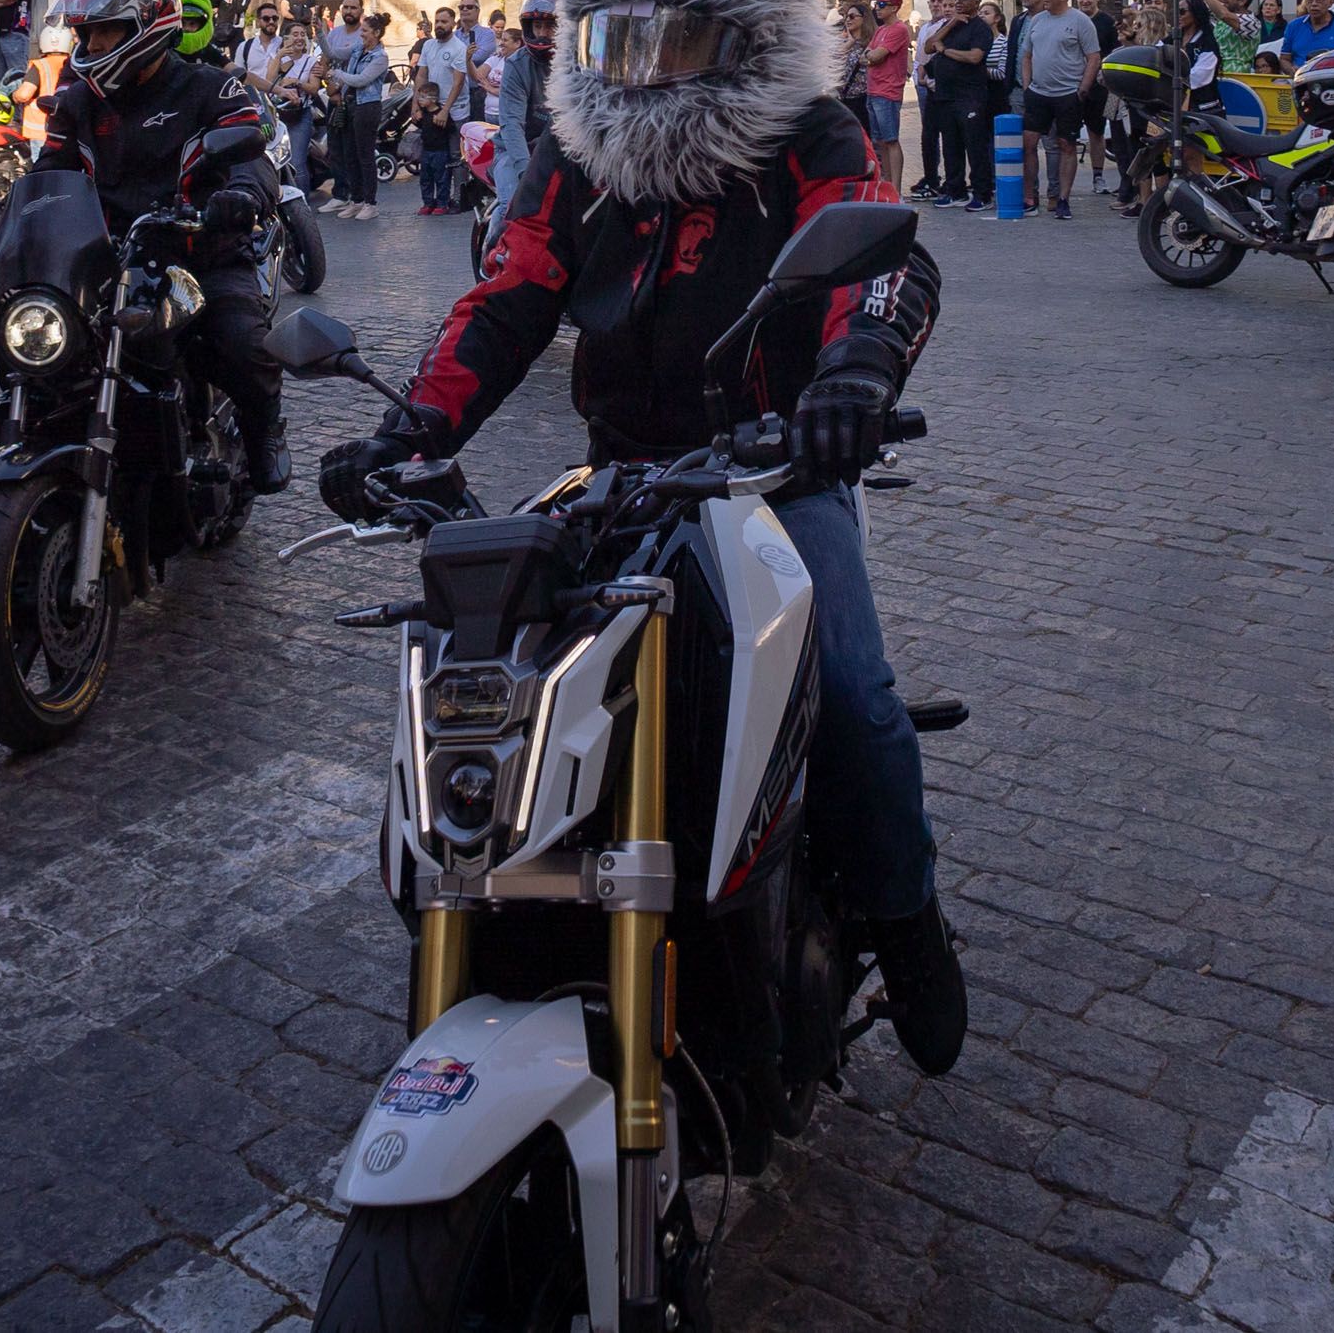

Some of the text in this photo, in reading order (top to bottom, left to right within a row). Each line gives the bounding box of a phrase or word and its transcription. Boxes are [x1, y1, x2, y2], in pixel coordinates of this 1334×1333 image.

[391, 1071, 466, 1095] Red Bull
[391, 1091, 444, 1106] JEREZ
